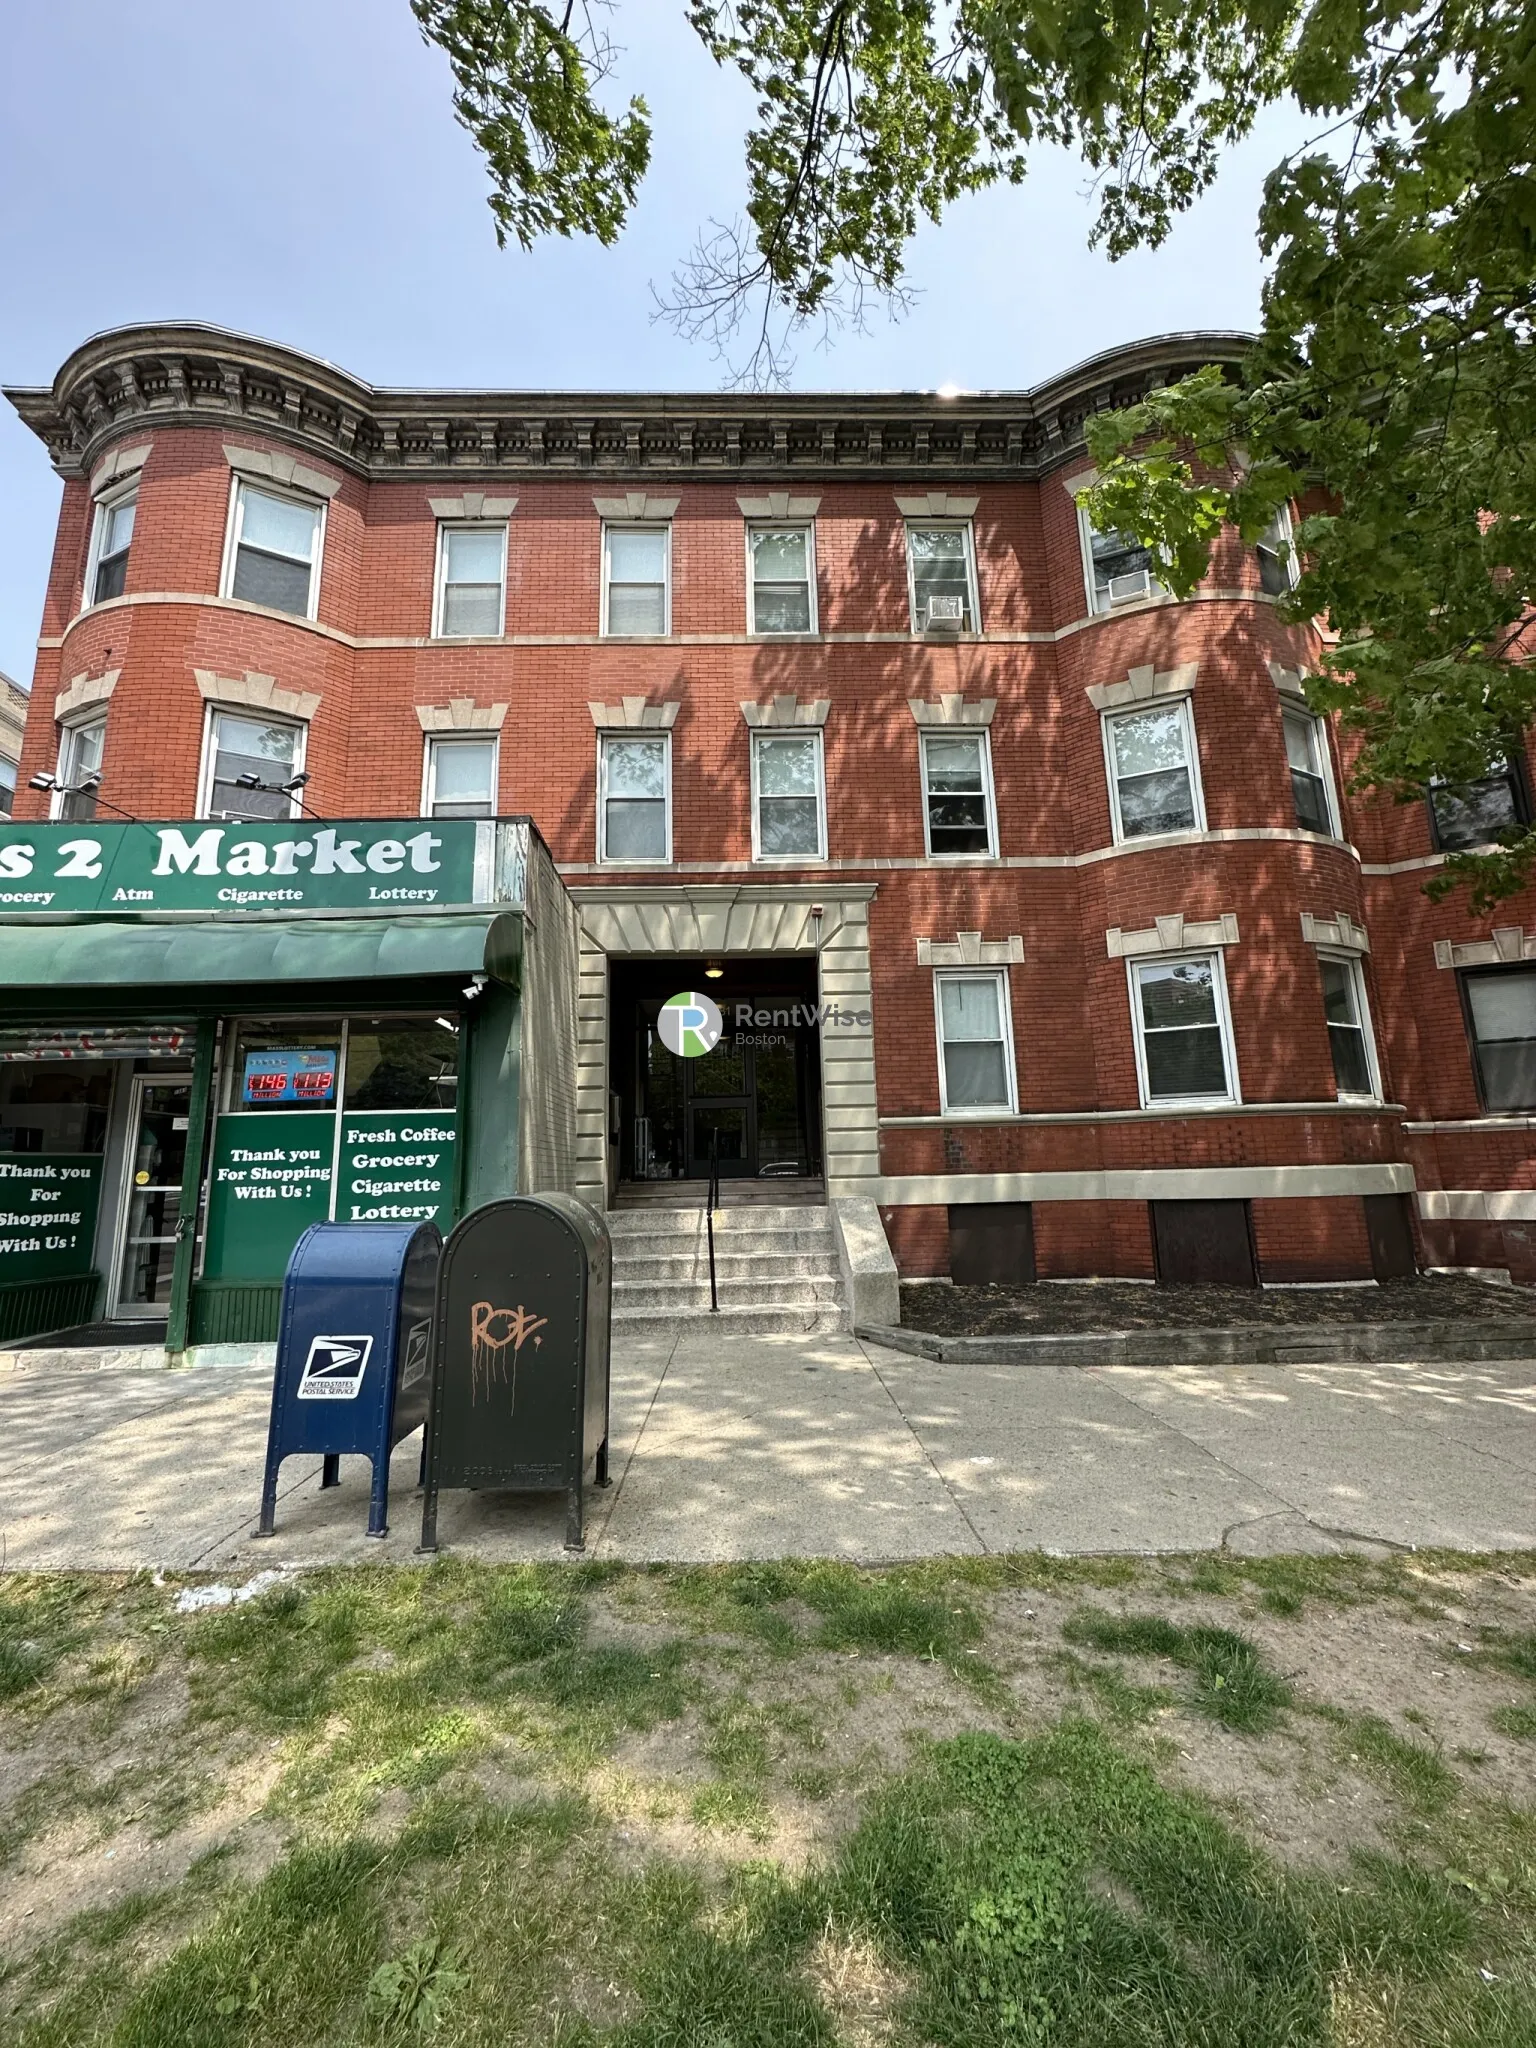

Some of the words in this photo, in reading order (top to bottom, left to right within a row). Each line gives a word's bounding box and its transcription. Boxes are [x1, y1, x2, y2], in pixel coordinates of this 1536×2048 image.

[54, 839, 103, 880] 2
[151, 828, 442, 876] Market
[112, 887, 154, 901] Atm
[217, 888, 304, 904] Cigarette
[369, 887, 438, 902] Lottery
[260, 1074, 287, 1089] 146
[304, 1073, 333, 1088] 113
[347, 1129, 396, 1143] Fresh
[400, 1128, 456, 1141] Coffee
[230, 1148, 286, 1162] Thank
[289, 1150, 320, 1162] you
[352, 1154, 440, 1168] Grocery
[0, 1164, 57, 1178] Thank
[60, 1168, 91, 1180] you
[217, 1168, 247, 1181] For
[250, 1166, 331, 1181] Shopping
[30, 1188, 61, 1201] For
[234, 1186, 276, 1199] With
[351, 1179, 441, 1196] Cigarette
[0, 1212, 81, 1226] Shopping
[350, 1205, 439, 1220] Lottery
[0, 1238, 40, 1253] With
